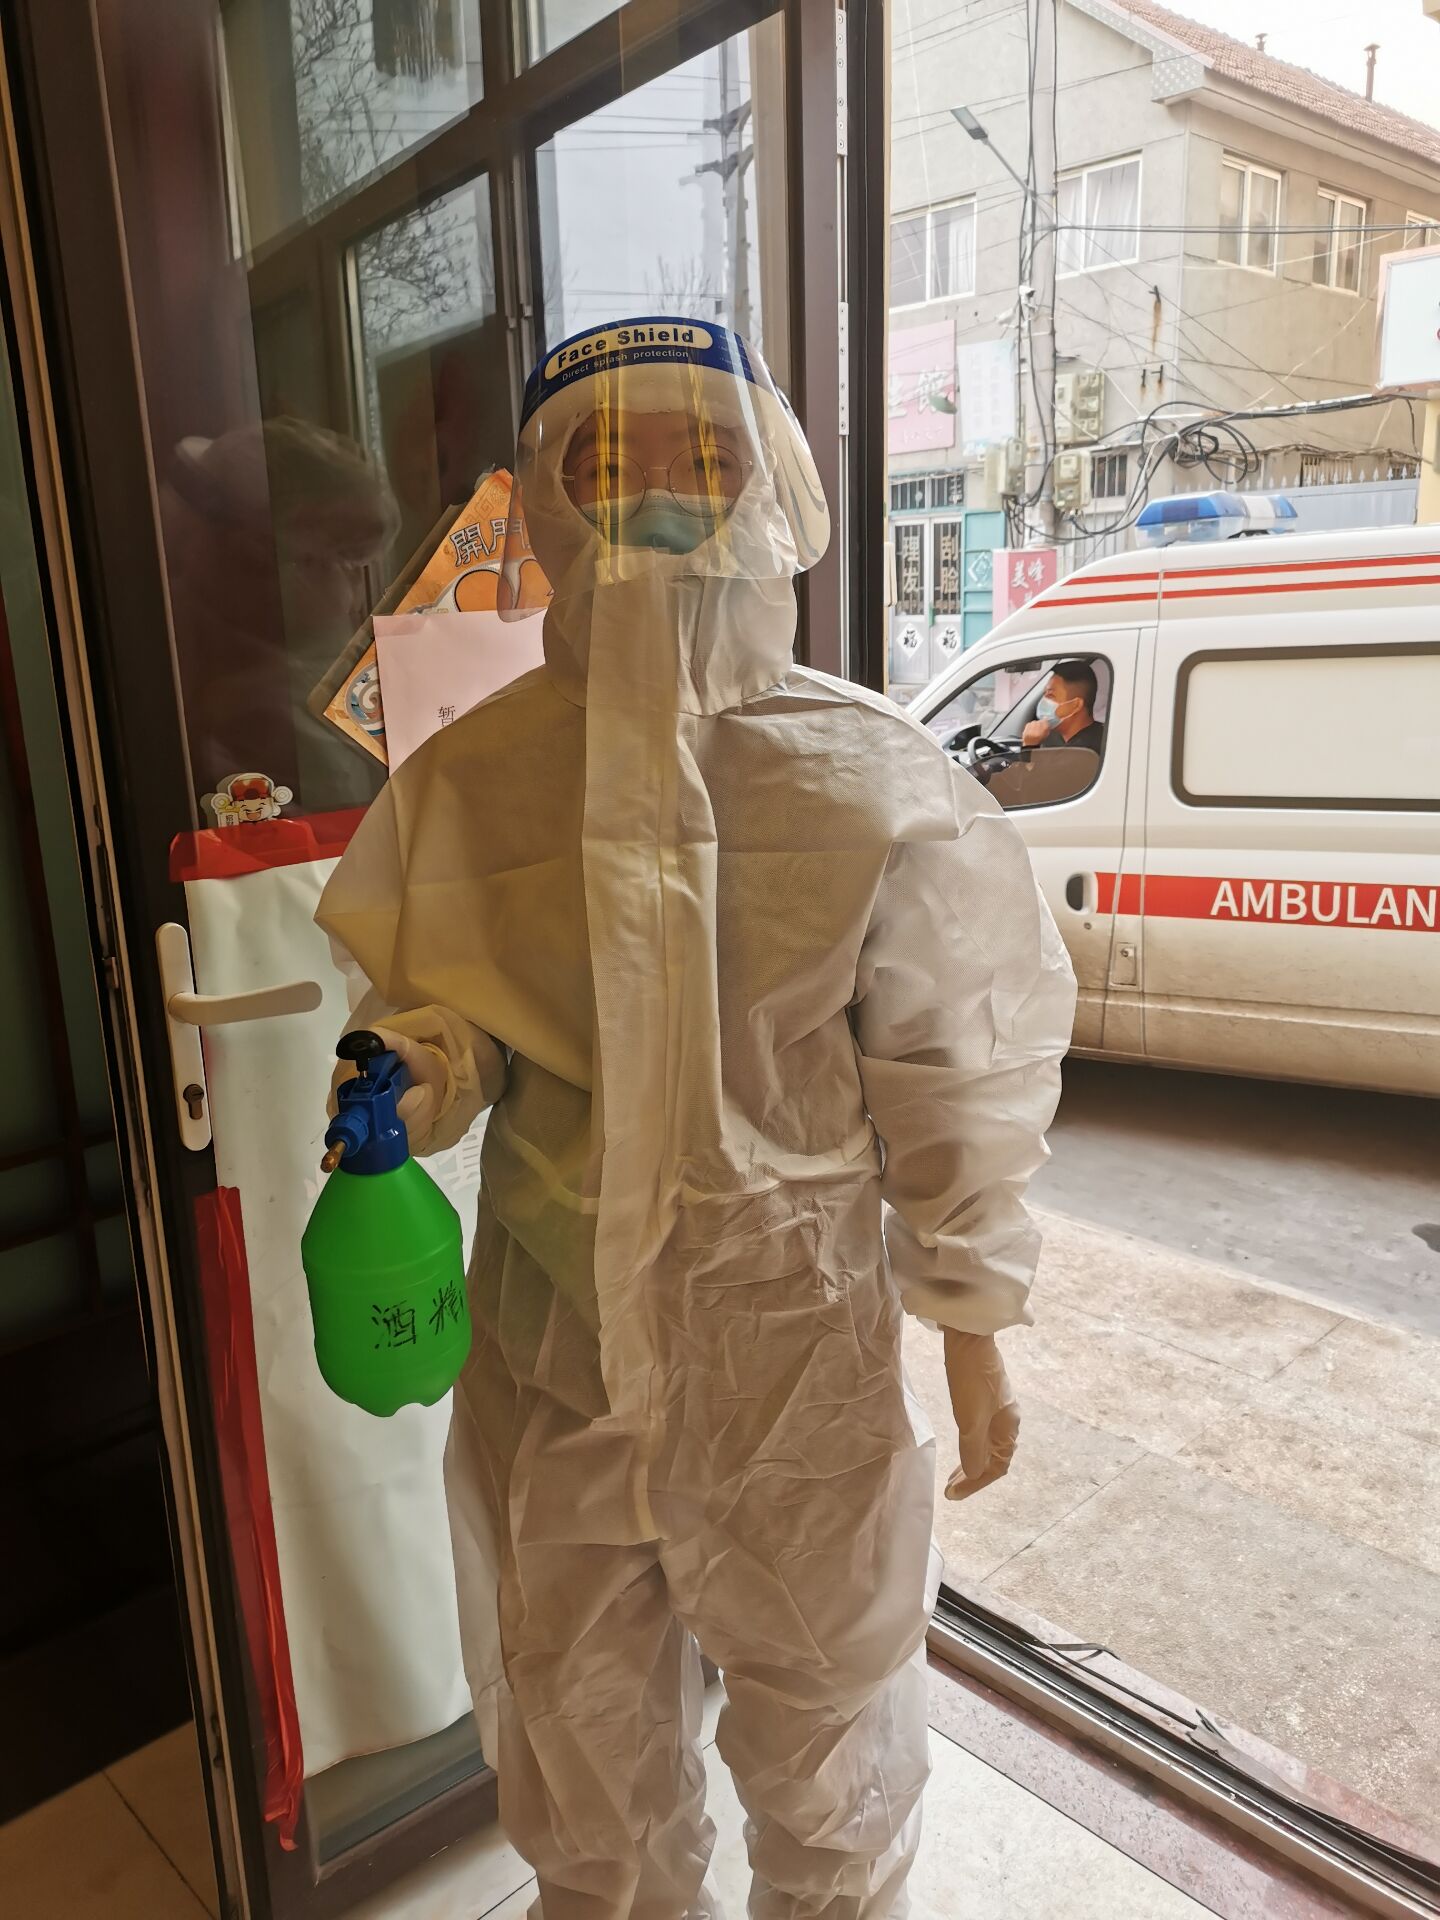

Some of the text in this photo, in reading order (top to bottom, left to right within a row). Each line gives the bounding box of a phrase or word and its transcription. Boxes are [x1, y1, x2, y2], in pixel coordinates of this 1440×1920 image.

[558, 328, 694, 369] Face Shield
[562, 350, 689, 381] Direct splash protection
[438, 705, 456, 727] 暂
[1211, 880, 1437, 928] AMBULAN
[371, 1279, 465, 1350] 酒精
